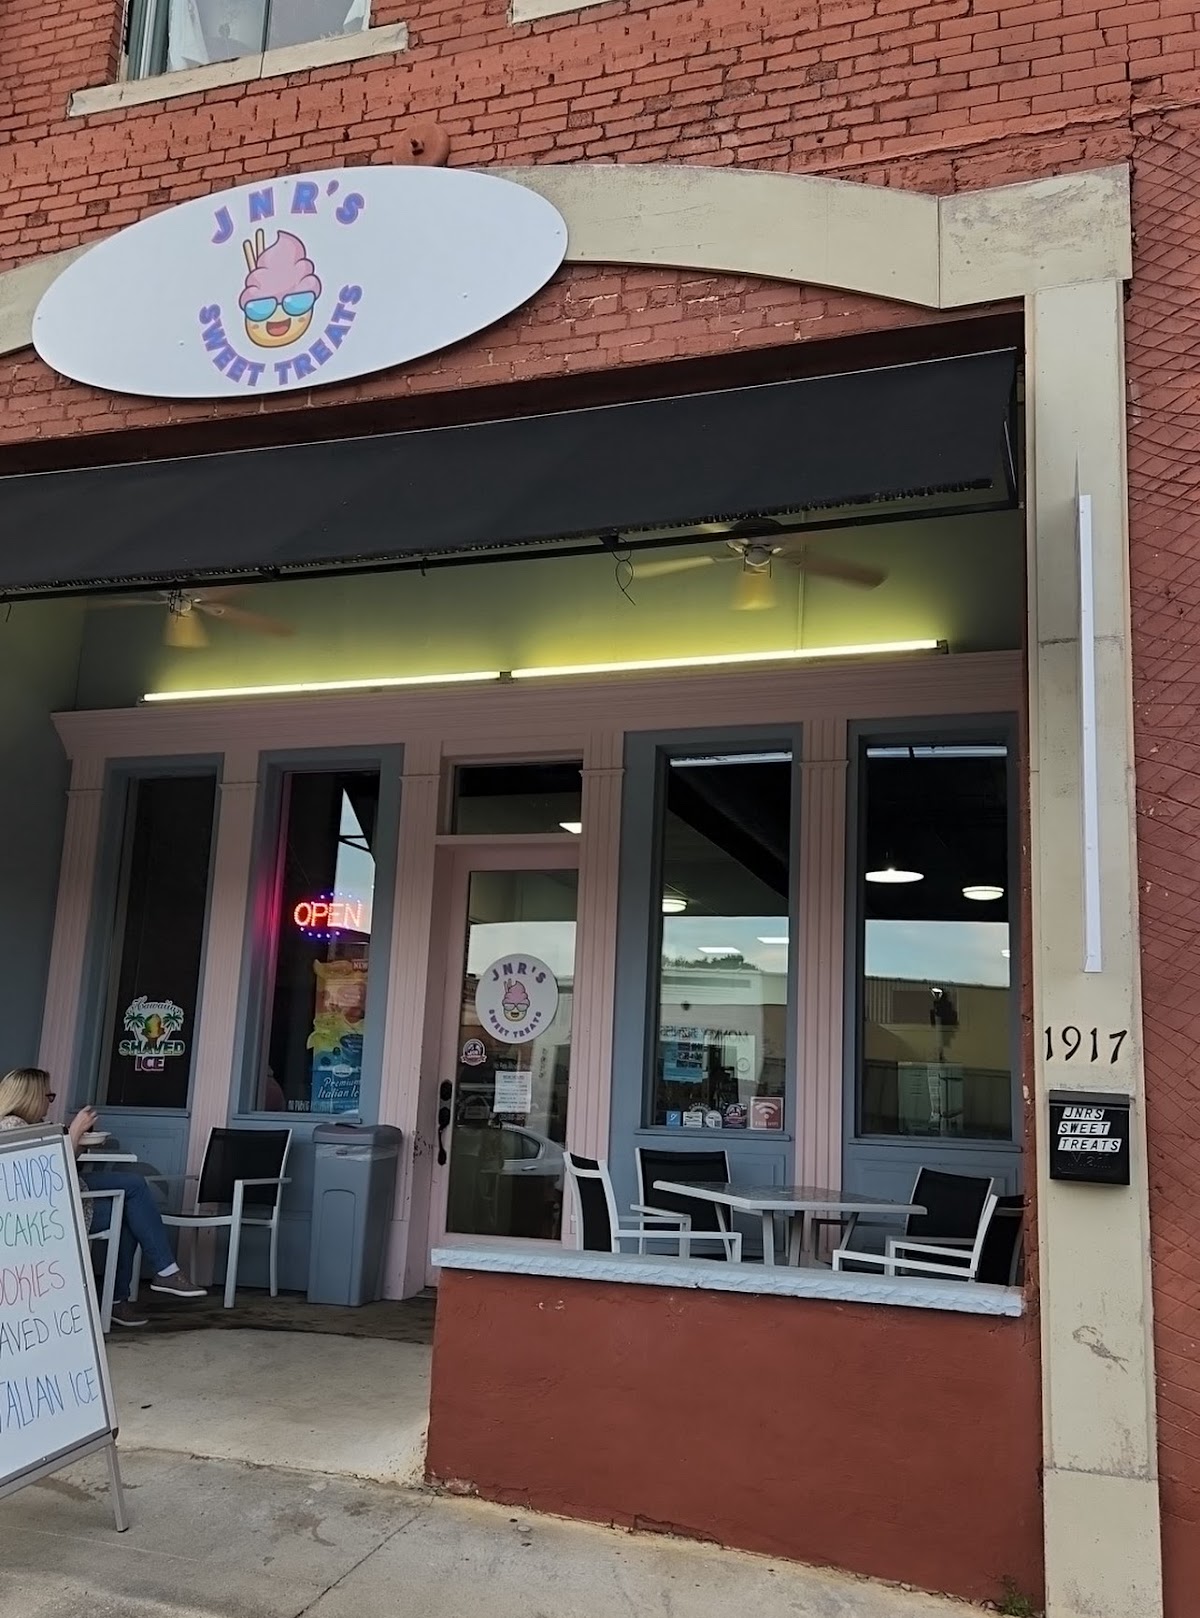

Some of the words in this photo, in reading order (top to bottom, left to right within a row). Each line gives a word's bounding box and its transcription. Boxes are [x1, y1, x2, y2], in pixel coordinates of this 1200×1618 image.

[199, 304, 266, 387] SWEET
[273, 284, 363, 386] TREATS
[293, 902, 362, 928] OPEN
[491, 962, 547, 984] JNR'S
[488, 1009, 509, 1037] SWEET
[512, 1011, 542, 1038] TREATS
[120, 1040, 185, 1055] SHAVED
[1044, 1025, 1128, 1064] 1917
[135, 1056, 164, 1071] ICE
[317, 1086, 349, 1098] Italian
[1064, 1107, 1104, 1120] JNRS
[1059, 1122, 1109, 1135] SWEET
[1061, 1137, 1120, 1151] TREATS
[0, 1153, 64, 1208] LAVORS
[0, 1317, 50, 1359] AVED
[53, 1304, 84, 1338] ICE
[69, 1367, 99, 1408] ICE
